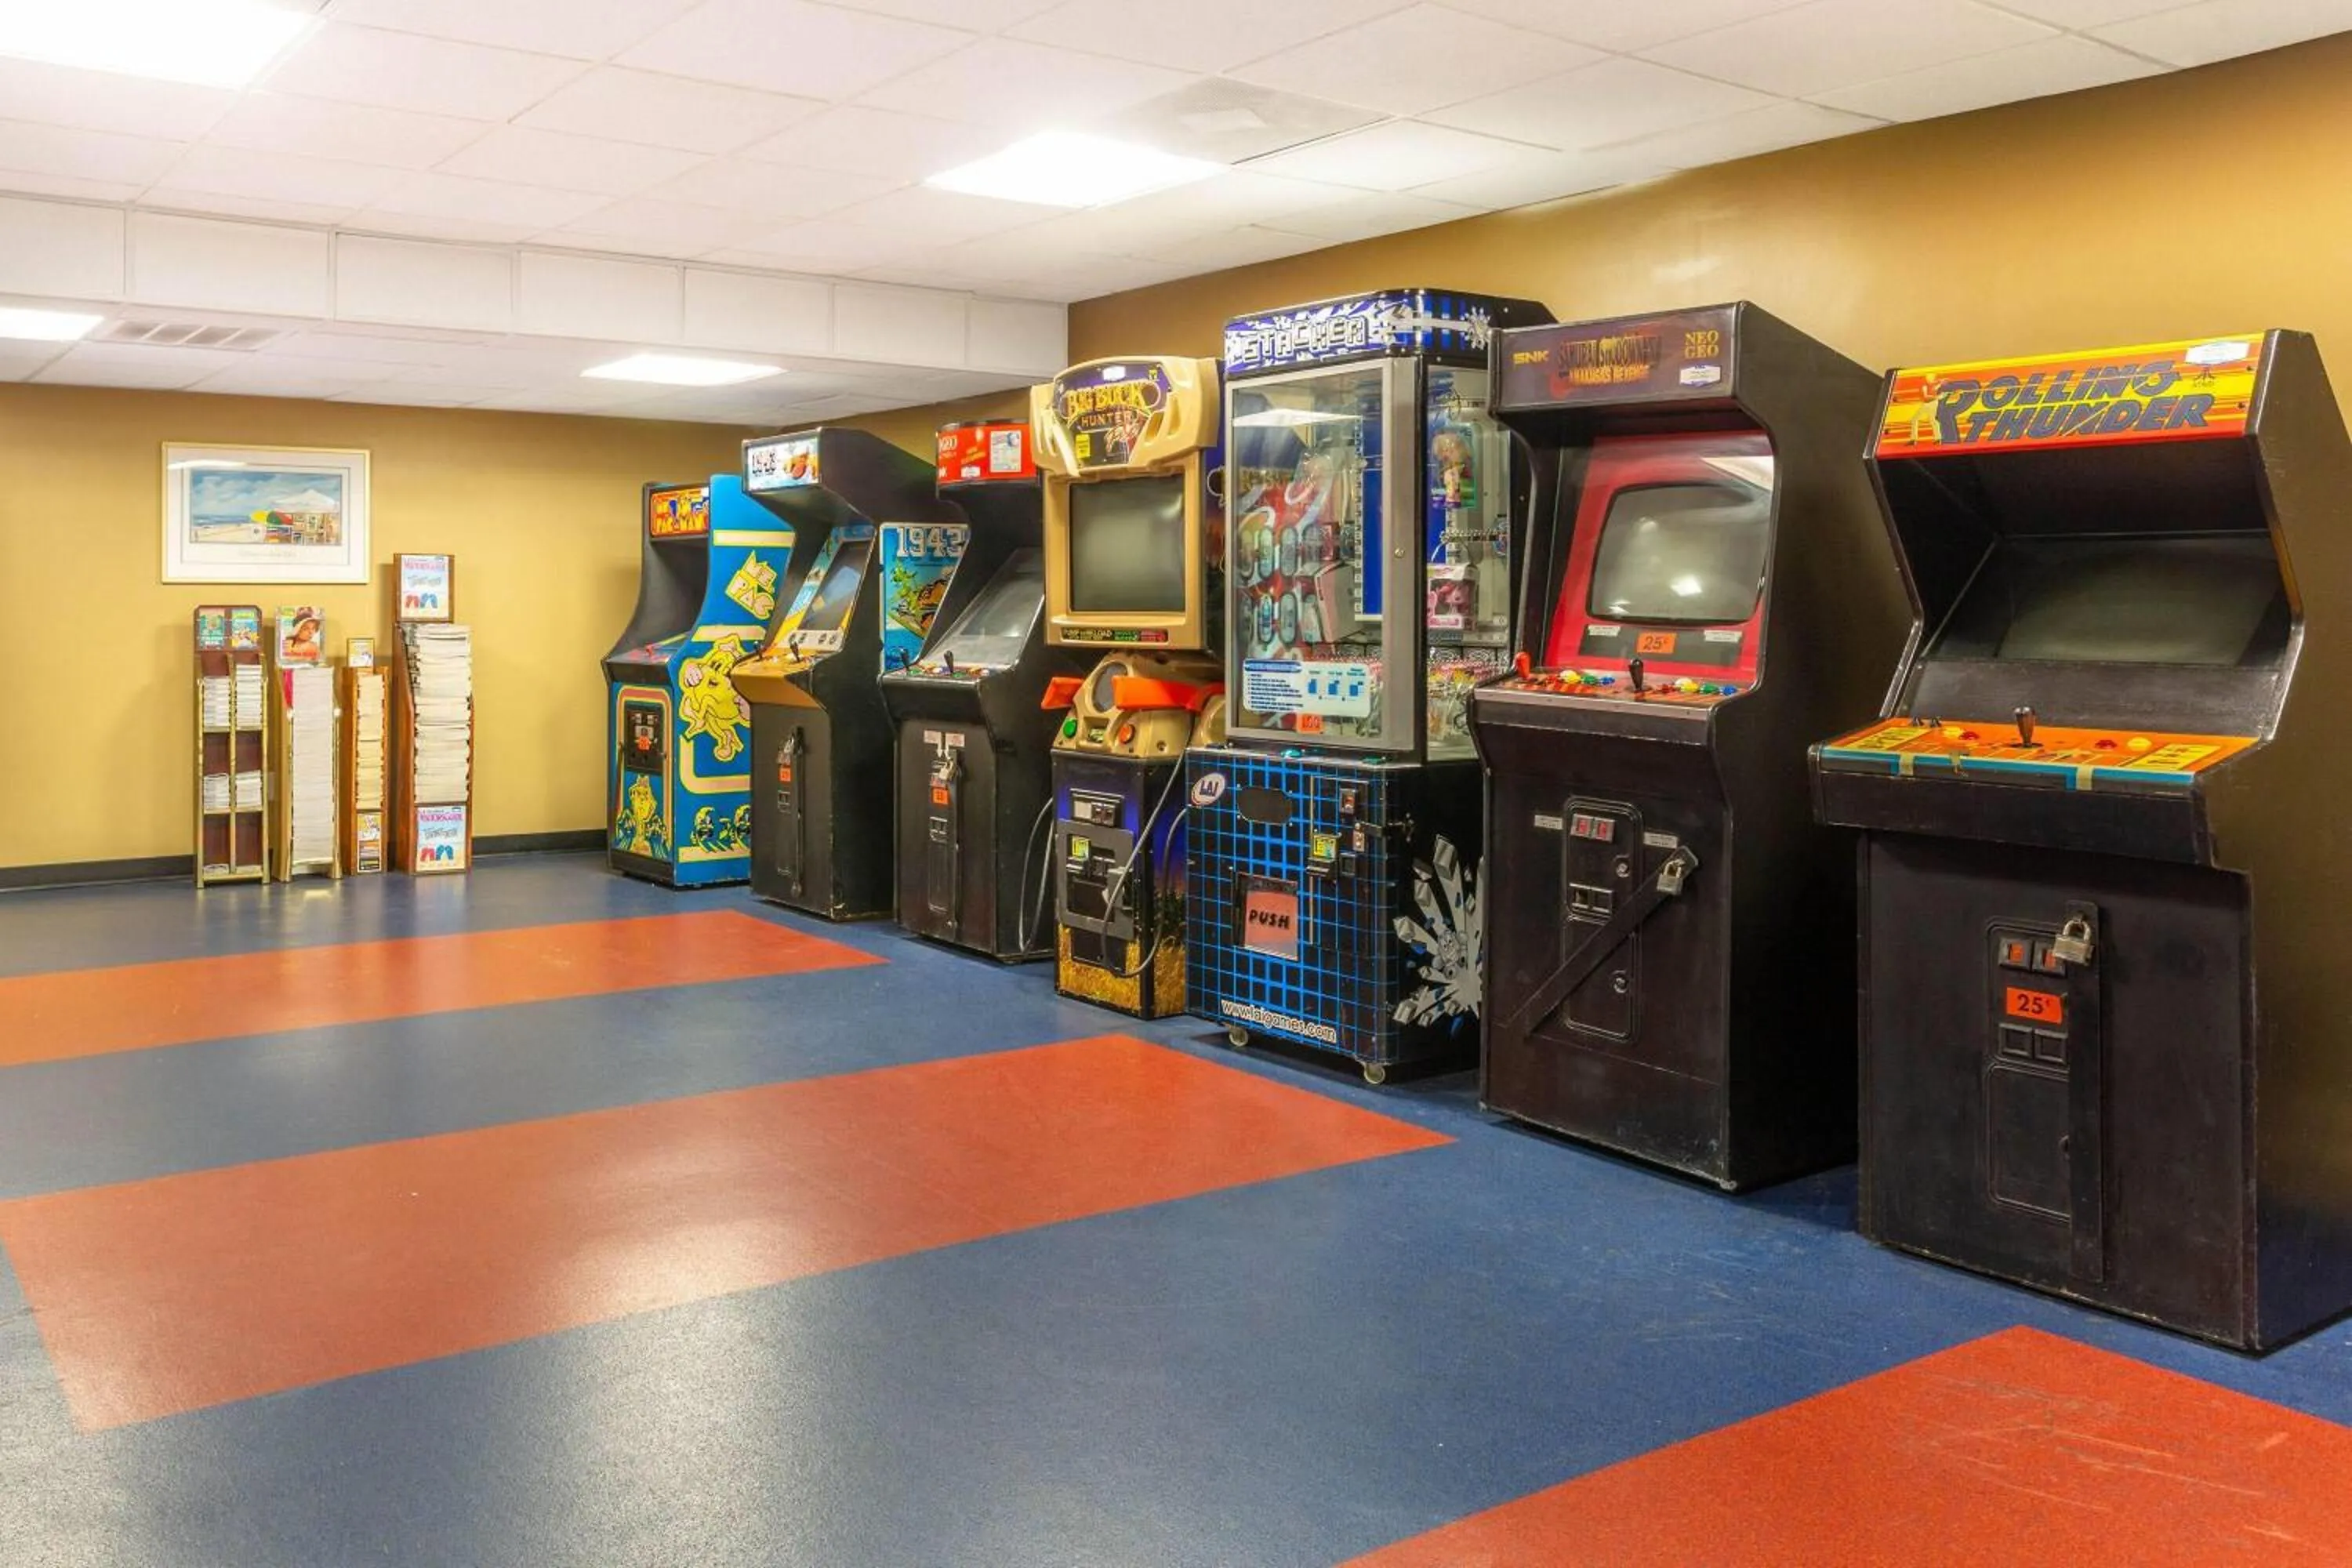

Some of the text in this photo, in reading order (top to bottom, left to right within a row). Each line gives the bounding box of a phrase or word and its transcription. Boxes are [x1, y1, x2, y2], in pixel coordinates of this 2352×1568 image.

[1242, 314, 1366, 363] STACKER
[1685, 343, 1719, 358] GEO
[1686, 329, 1719, 345] NEO
[1512, 350, 1550, 365] SNK
[1068, 383, 1148, 417] BIG BUCK
[1938, 360, 2182, 444] ROLLING
[1081, 409, 1134, 428] HUNTER
[1965, 394, 2216, 442] THUNDER
[896, 527, 970, 557] 1943
[1249, 909, 1290, 930] PUSH
[1221, 1000, 1338, 1044] www.laigames.com
